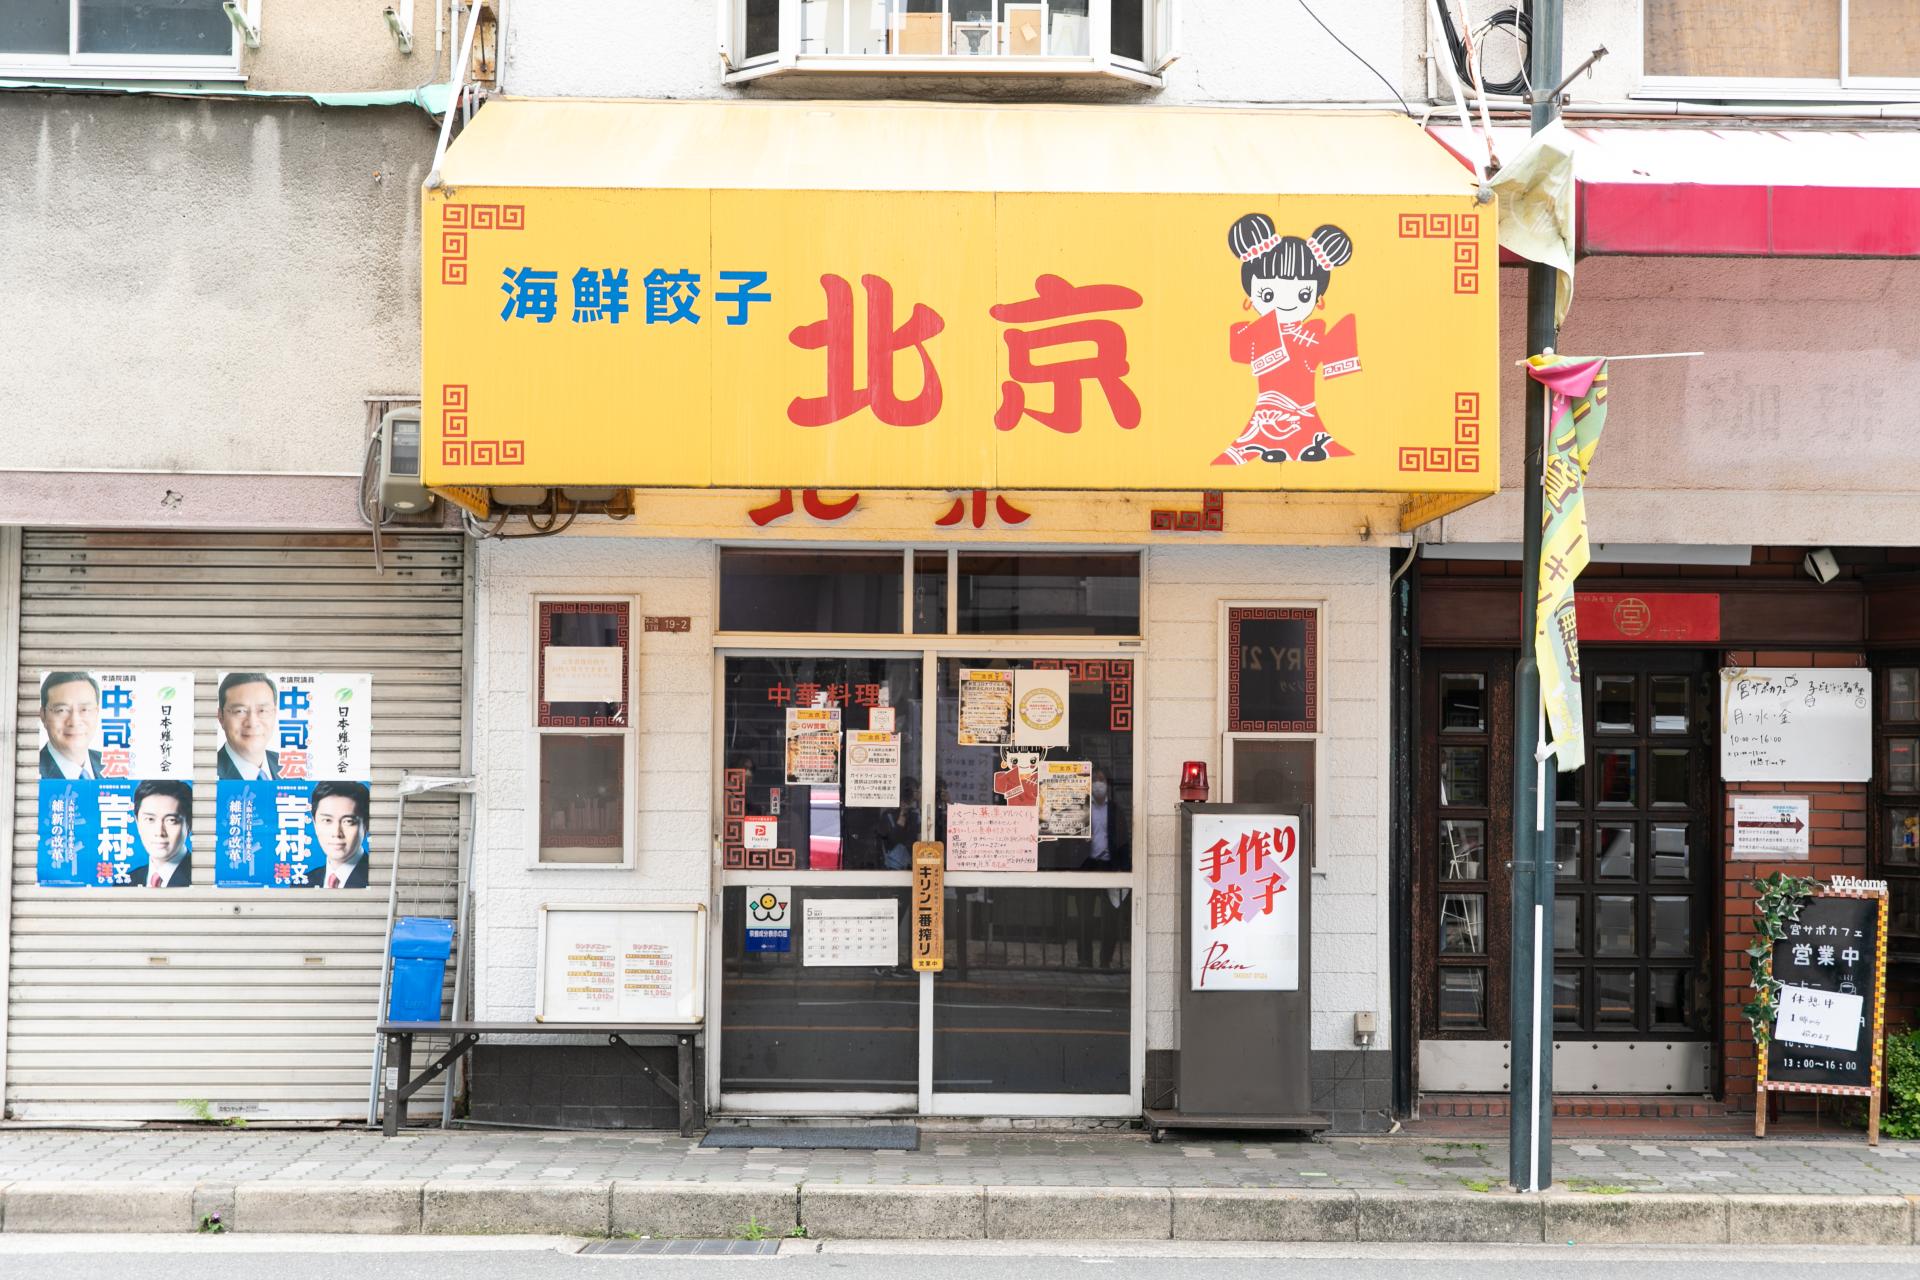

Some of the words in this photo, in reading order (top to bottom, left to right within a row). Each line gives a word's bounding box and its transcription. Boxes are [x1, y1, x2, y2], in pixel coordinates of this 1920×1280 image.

[501, 266, 772, 326] 海鮮餃子
[788, 273, 1144, 434] 北京
[664, 619, 688, 630] 19-2
[768, 682, 881, 708] 中華料理
[51, 799, 65, 861] 維新の改革
[229, 800, 242, 861] 維新の改革
[1198, 825, 1296, 883] 手作り
[918, 866, 932, 956] キリン一番搾り
[1206, 872, 1288, 930] 餃子
[1831, 875, 1888, 889] Welcome
[807, 908, 813, 916] 5
[1790, 924, 1863, 937] 宮サポカフェ
[1792, 943, 1860, 967] 営業中
